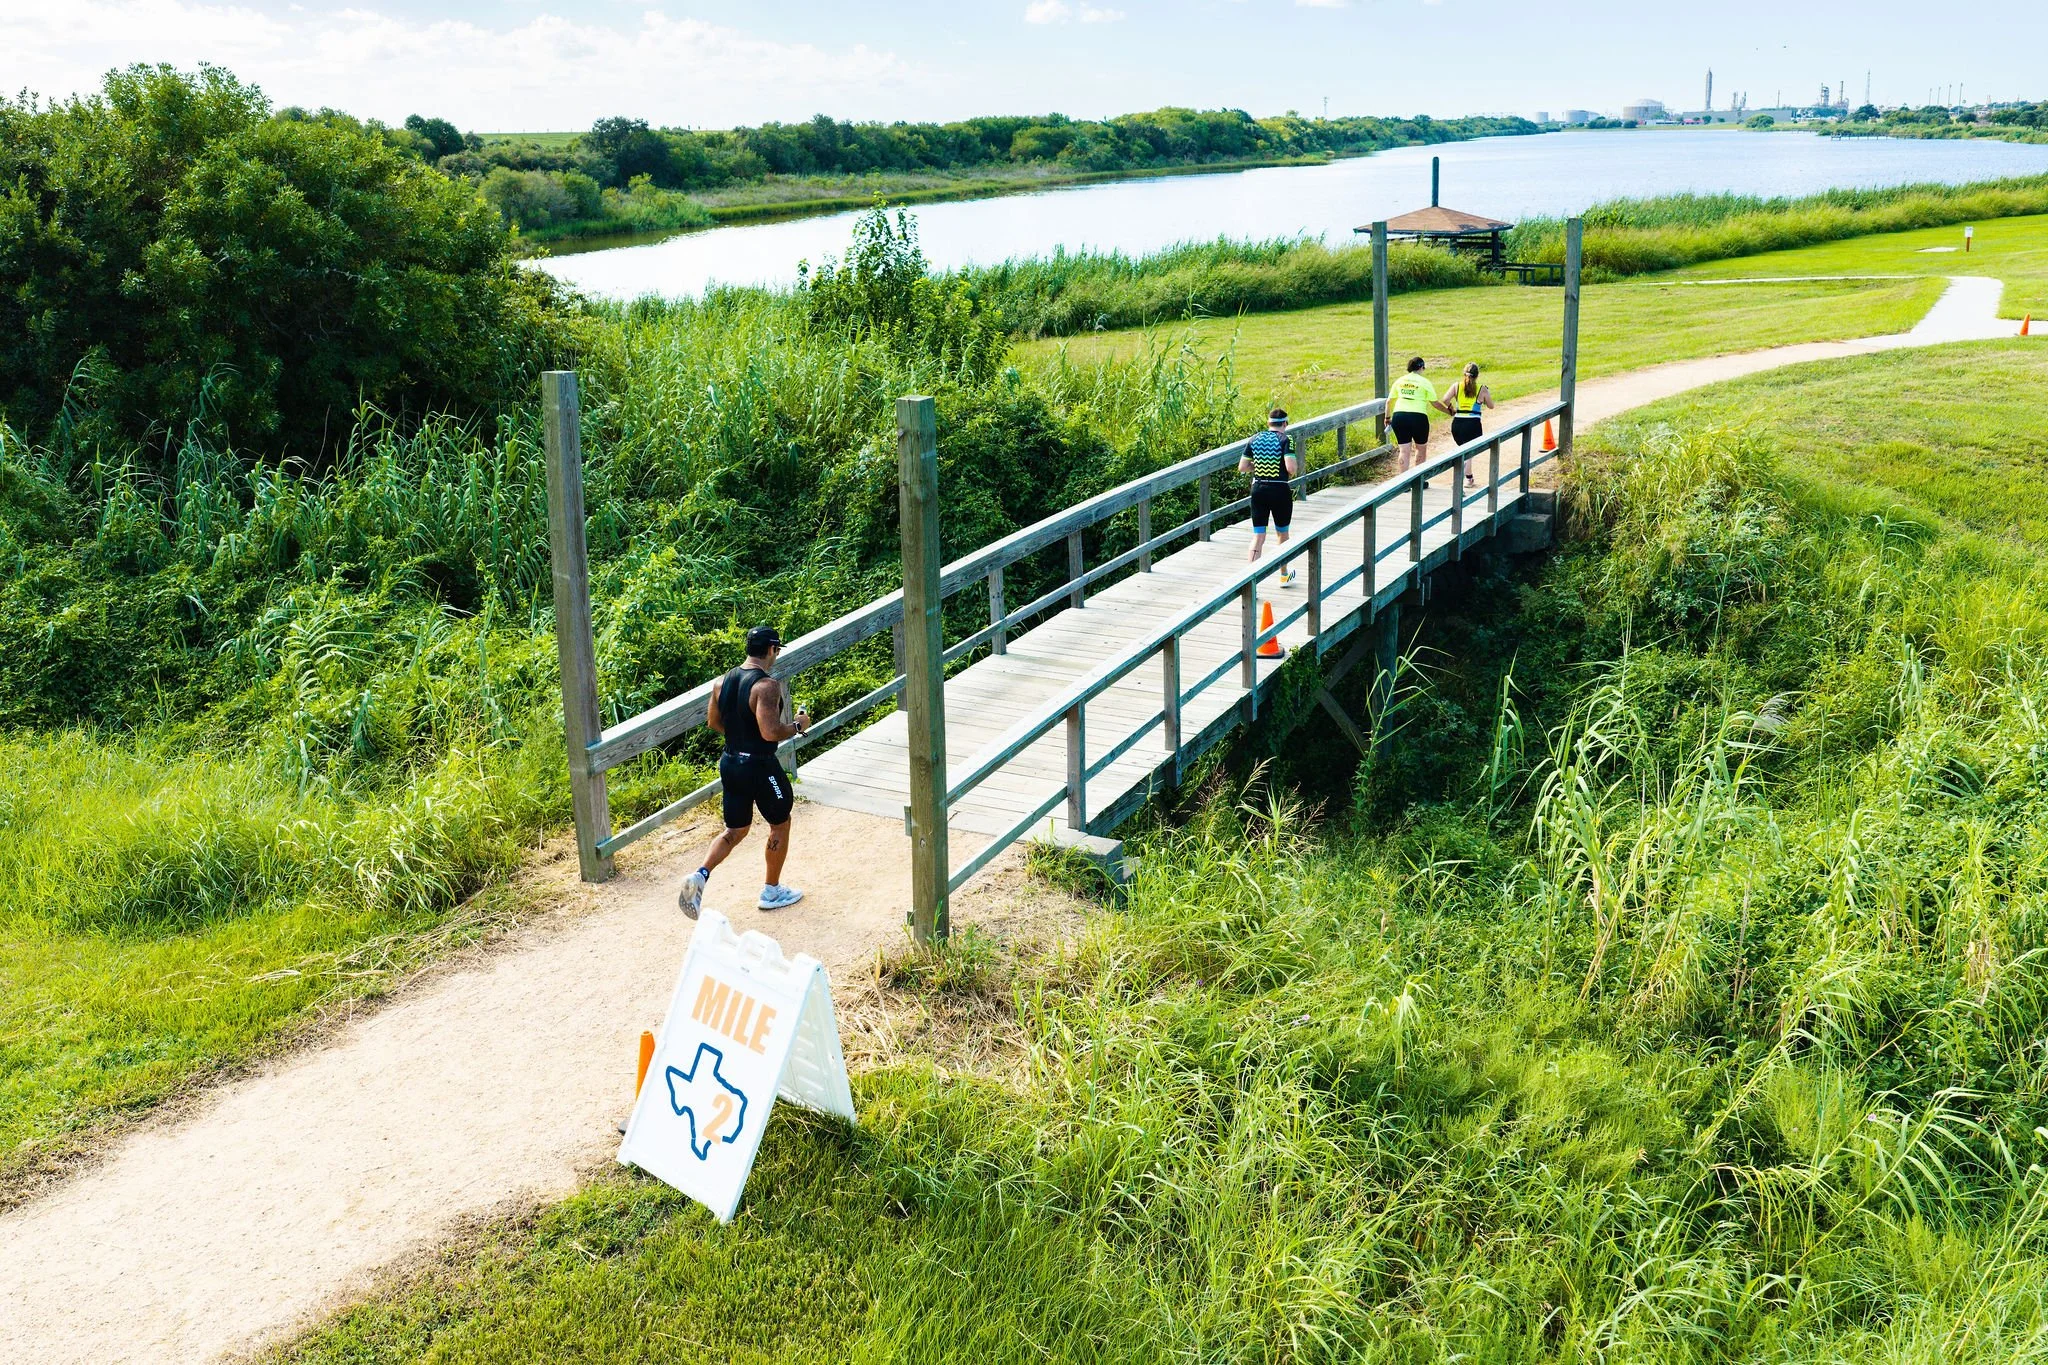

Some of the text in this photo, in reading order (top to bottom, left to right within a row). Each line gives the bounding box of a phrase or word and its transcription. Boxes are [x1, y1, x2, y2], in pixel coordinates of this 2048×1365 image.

[768, 775, 784, 800] SPARX
[691, 974, 777, 1055] MILE
[702, 1093, 733, 1145] 2
